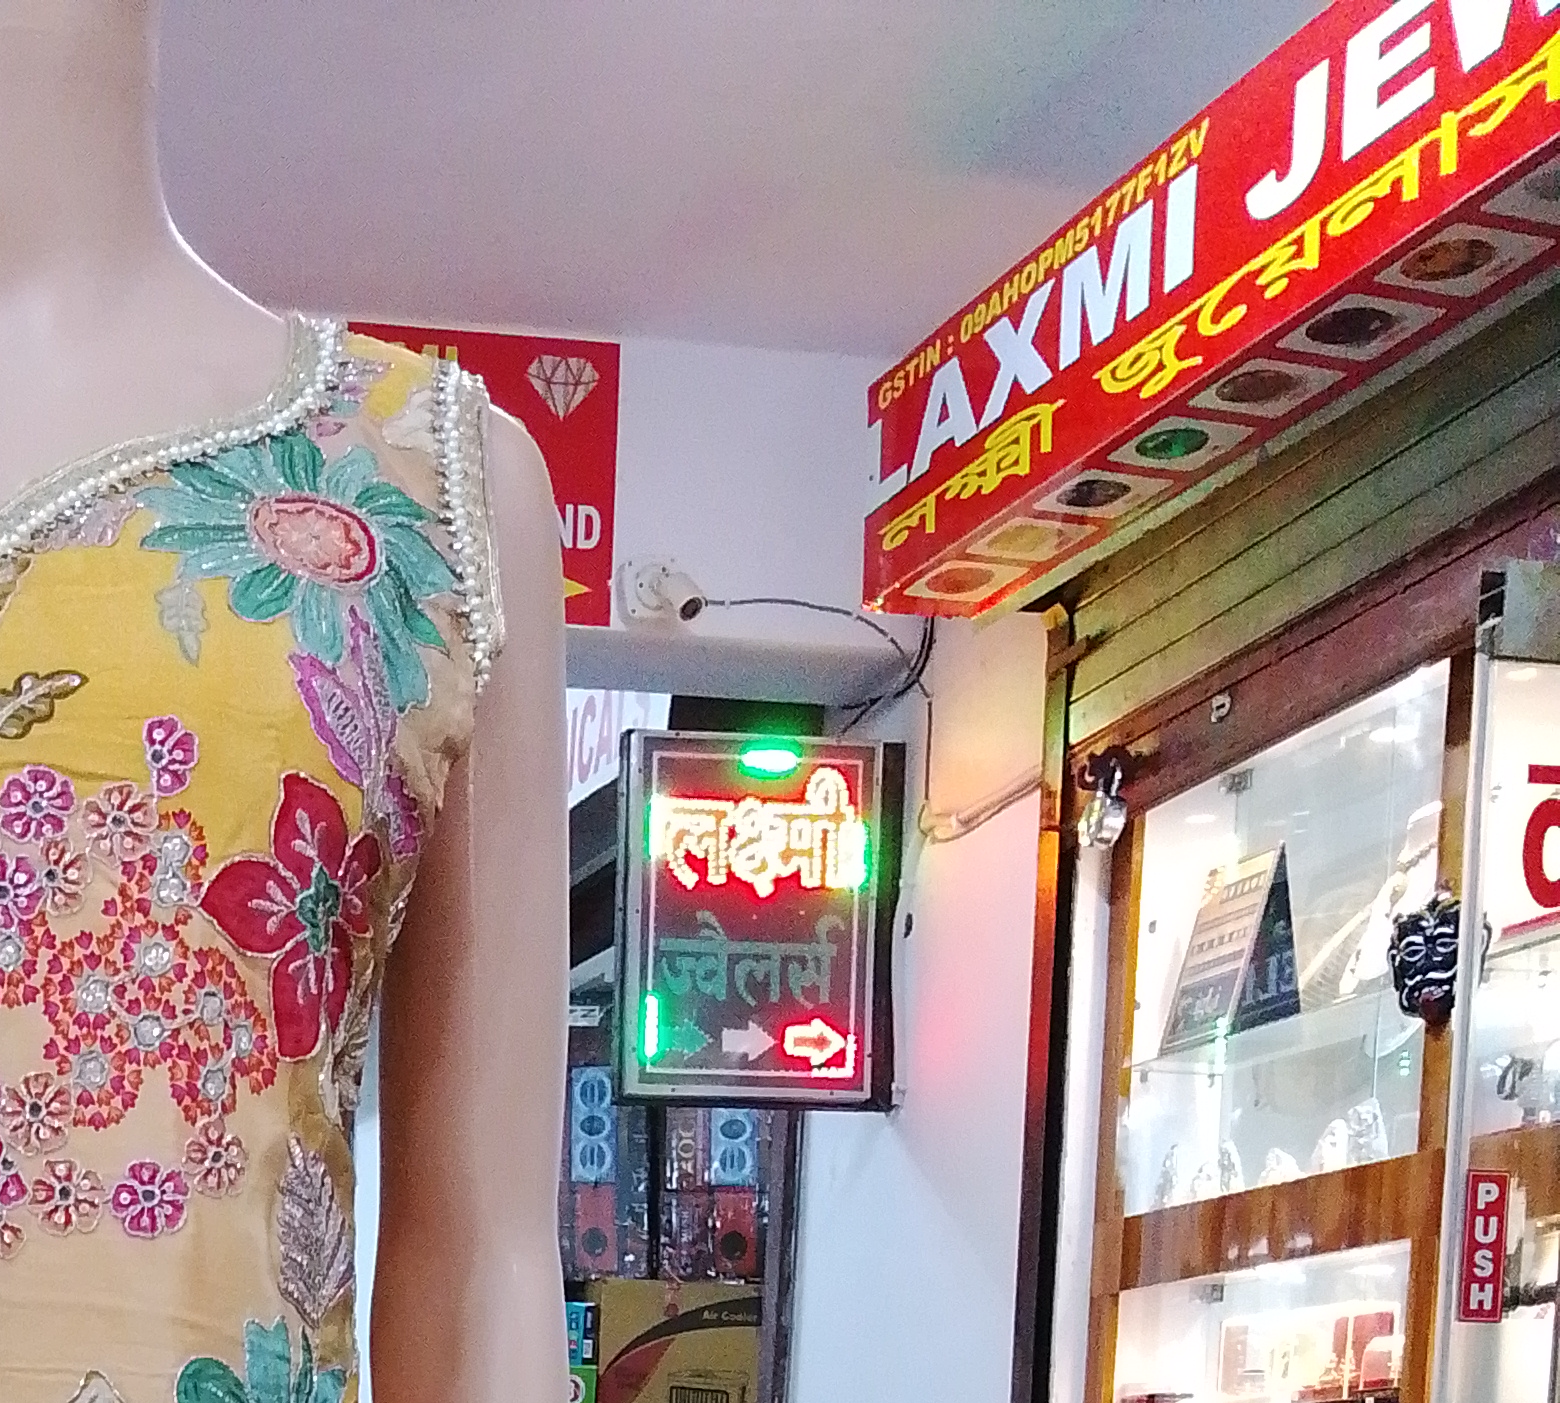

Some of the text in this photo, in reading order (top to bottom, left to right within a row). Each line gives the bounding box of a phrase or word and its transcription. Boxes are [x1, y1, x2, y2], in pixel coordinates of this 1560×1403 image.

[864, 164, 1198, 518] LAXMI
[878, 340, 941, 409] GSTIN
[1468, 1181, 1500, 1312] PUSH
